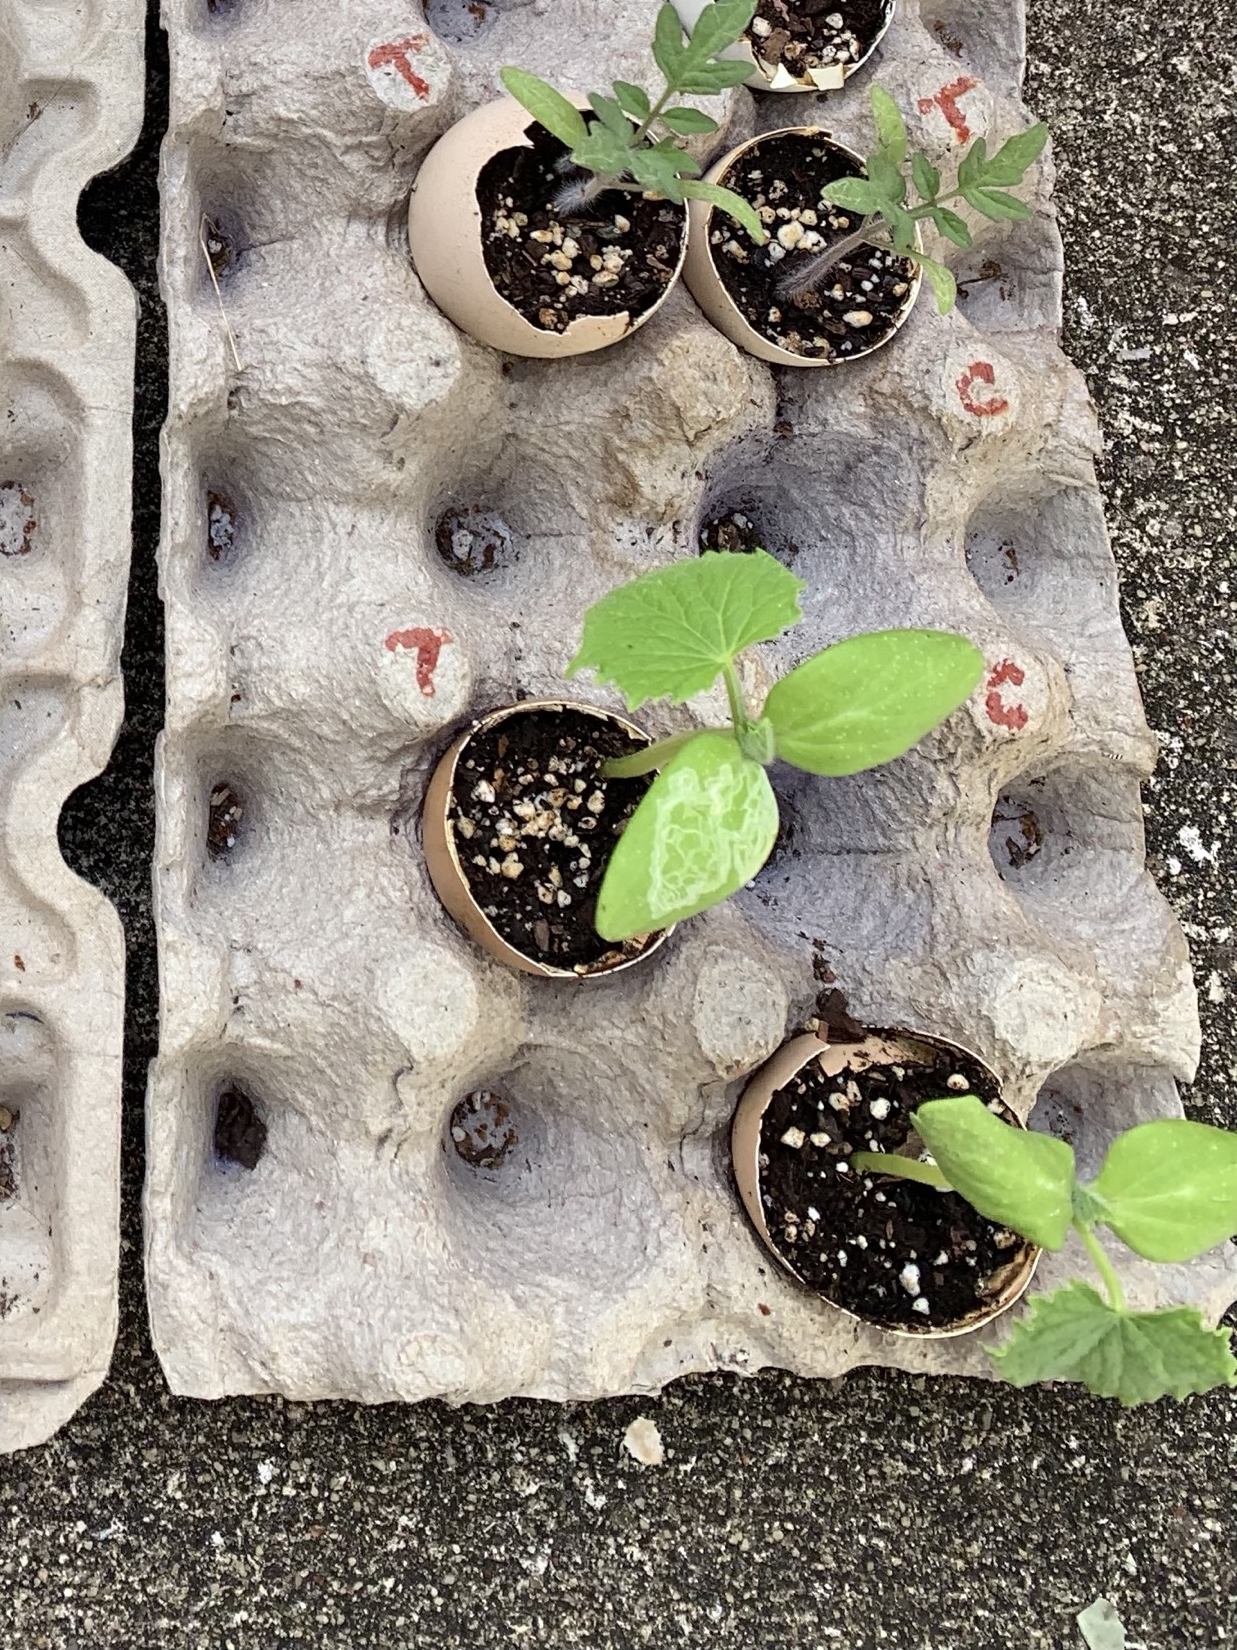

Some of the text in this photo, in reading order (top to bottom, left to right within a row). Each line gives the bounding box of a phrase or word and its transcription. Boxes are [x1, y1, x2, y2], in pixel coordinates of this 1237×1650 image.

[368, 33, 430, 103] T
[918, 76, 980, 144] T
[955, 361, 1009, 417] C
[385, 627, 453, 698] T
[986, 658, 1029, 730] C
